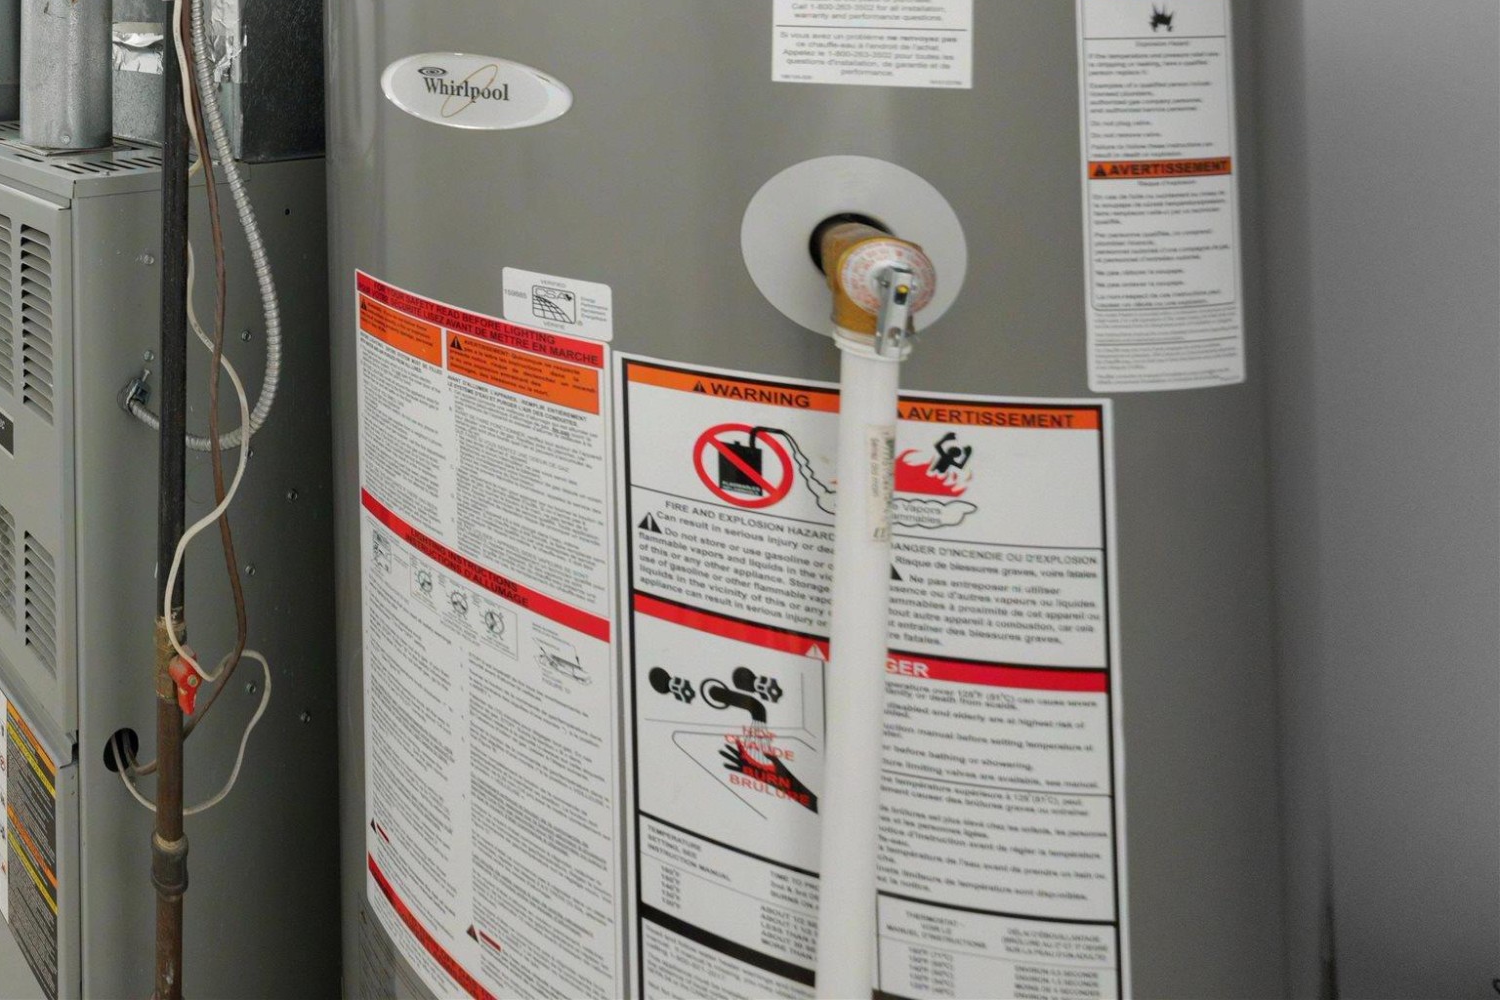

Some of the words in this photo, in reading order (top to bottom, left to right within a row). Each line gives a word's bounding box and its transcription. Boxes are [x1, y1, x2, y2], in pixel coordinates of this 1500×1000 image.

[423, 77, 509, 103] Whirlpool
[1109, 160, 1227, 175] AVERTISSEMENT
[473, 327, 488, 338] DE
[489, 330, 530, 351] METTRE
[531, 341, 547, 354] EN
[549, 347, 598, 365] MARCHE
[505, 325, 555, 345] LIGHTING
[711, 382, 810, 408] WARNING
[908, 407, 1075, 428] AVERTISSEMENT
[657, 511, 677, 523] Can
[680, 517, 709, 531] result
[711, 524, 722, 533] in
[725, 527, 764, 542] serious
[768, 534, 798, 549] injury
[802, 541, 814, 550] or
[665, 500, 689, 514] FIRE
[692, 507, 716, 519] AND
[718, 513, 784, 533] EXPLOSION
[639, 531, 687, 550] flammable
[690, 545, 724, 561] vapors
[727, 553, 745, 565] and
[749, 557, 783, 573] liquids
[787, 565, 797, 575] in
[799, 568, 816, 579] the
[664, 527, 678, 537] Do
[681, 531, 698, 543] not
[700, 537, 726, 549] store
[729, 543, 740, 551] or
[743, 548, 761, 557] use
[765, 551, 810, 567] gasoline
[813, 559, 825, 569] or
[639, 543, 648, 551] of
[651, 545, 668, 557] this
[671, 551, 681, 560] or
[683, 555, 701, 567] any
[704, 560, 730, 573] other
[789, 577, 830, 593] Storage
[639, 555, 655, 565] use
[658, 558, 668, 567] of
[670, 560, 710, 579] gasoline
[713, 572, 722, 581] or
[725, 575, 750, 589] other
[754, 582, 807, 600] flammable
[640, 575, 683, 594] appliance
[685, 588, 702, 599] can
[705, 594, 732, 607] result
[735, 601, 744, 609] in
[746, 604, 783, 618] serious
[786, 612, 814, 627] injury
[676, 574, 686, 584] in
[689, 578, 706, 589] the
[709, 584, 747, 600] vicinity
[751, 593, 762, 601] of
[765, 595, 785, 607] this
[789, 601, 801, 610] or
[804, 605, 824, 617] any
[884, 657, 929, 677] GER
